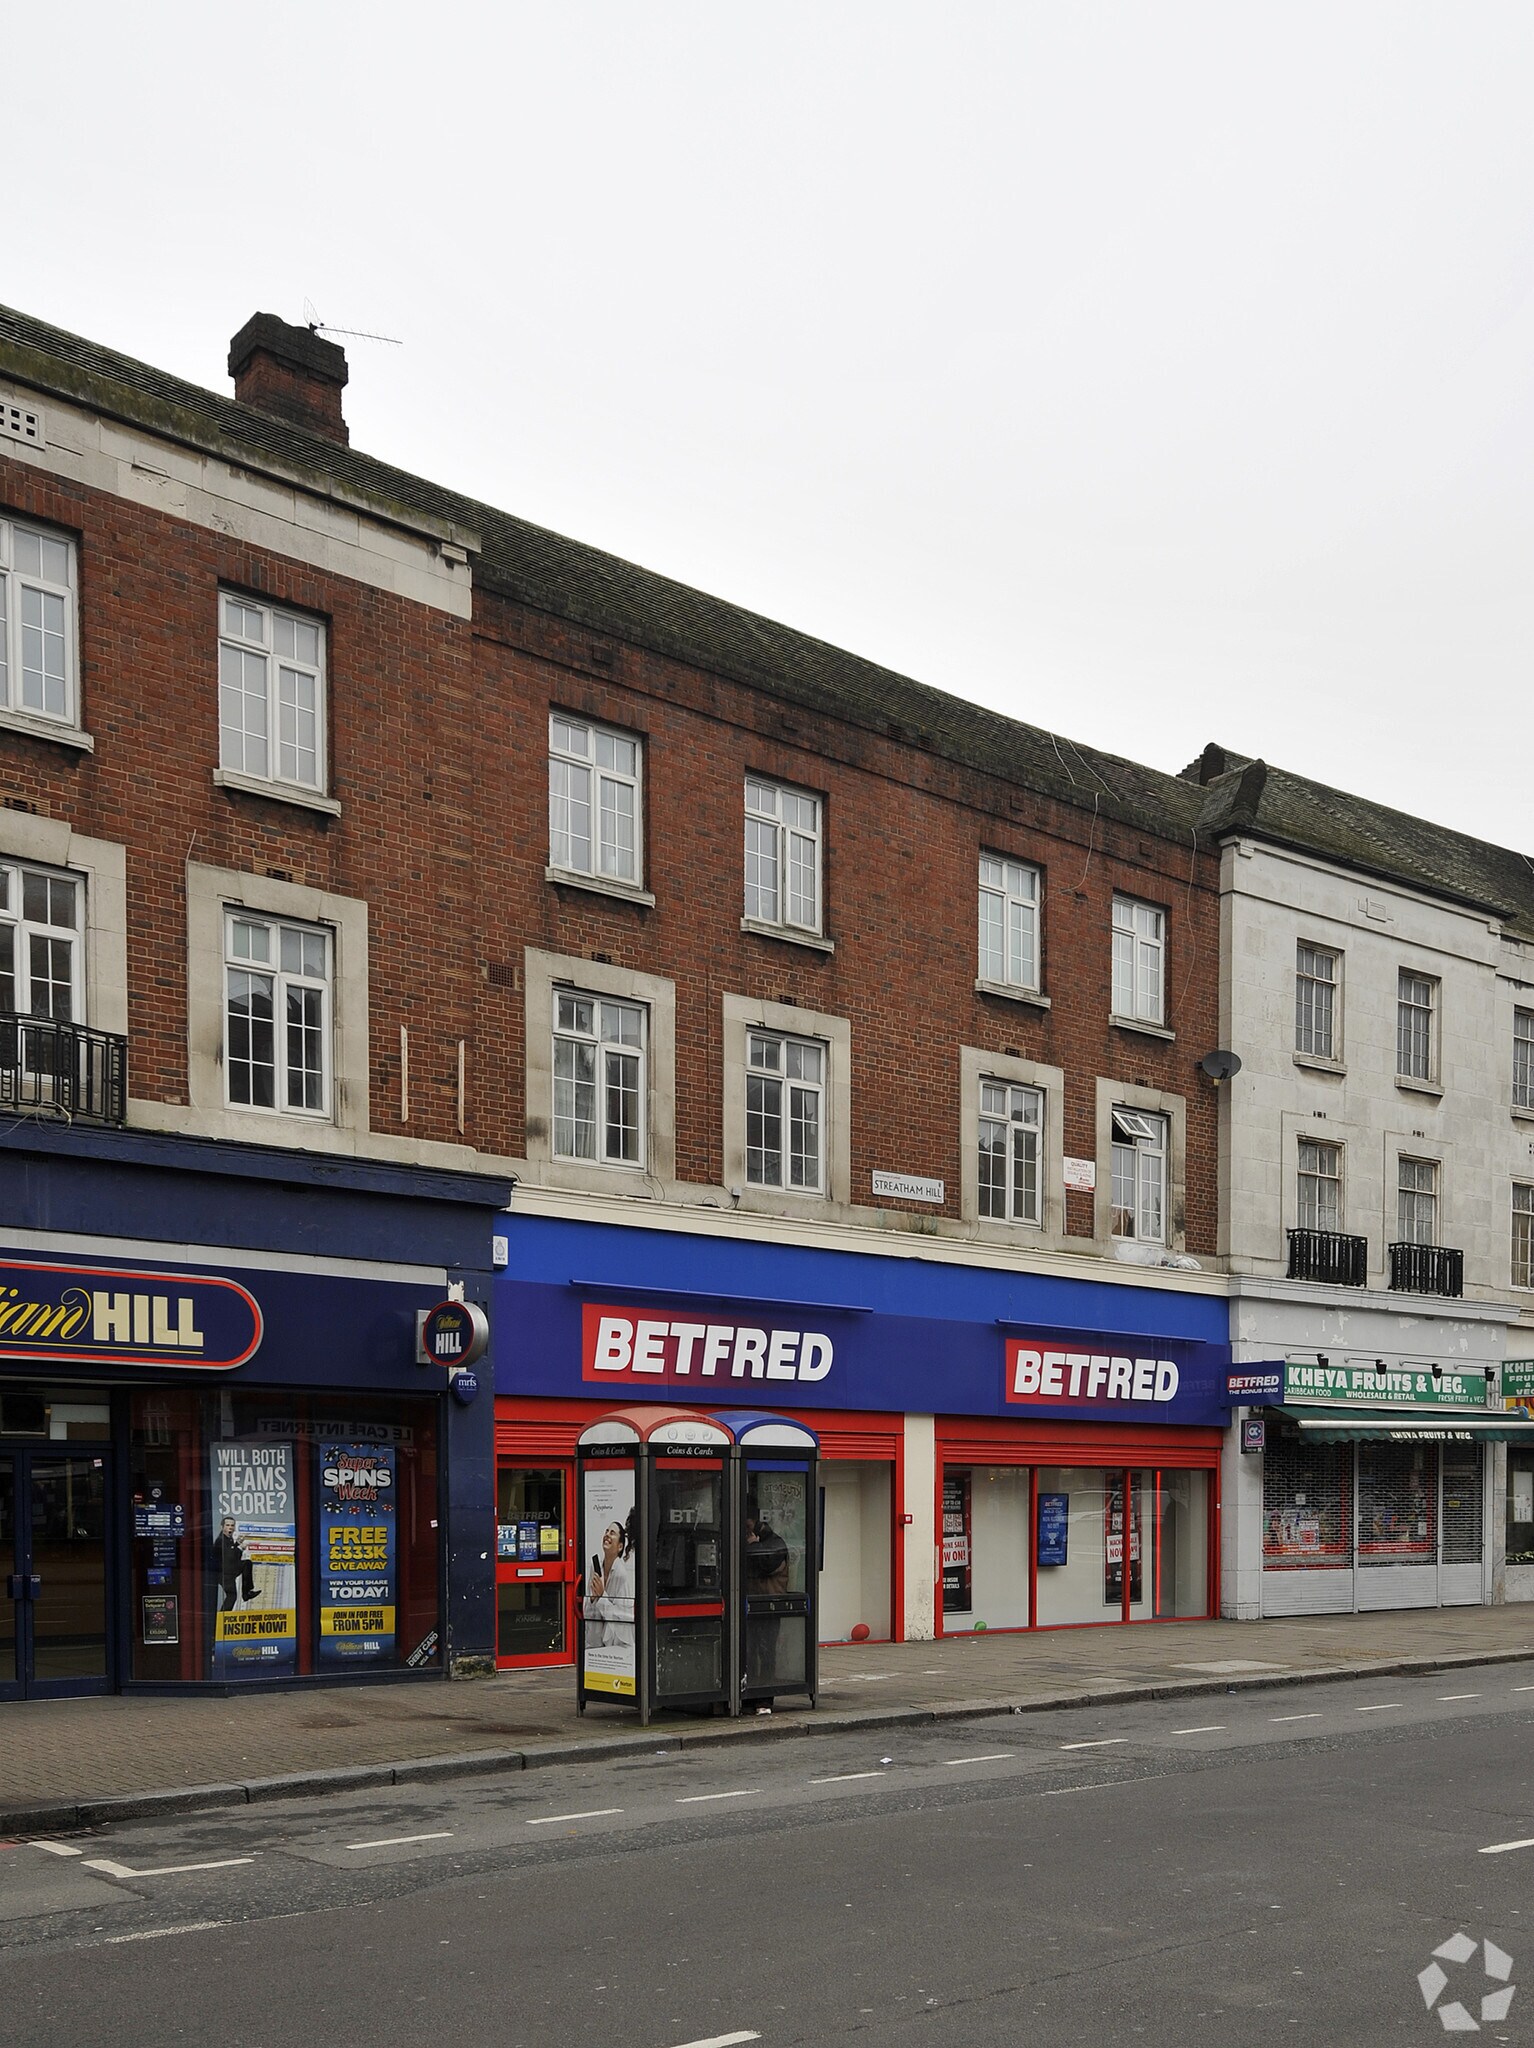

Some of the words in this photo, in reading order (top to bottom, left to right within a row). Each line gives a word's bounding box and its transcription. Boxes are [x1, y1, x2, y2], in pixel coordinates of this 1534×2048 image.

[874, 1179, 923, 1195] STREATHAM
[925, 1187, 942, 1198] HILL
[0, 1286, 92, 1340] iam
[93, 1291, 204, 1347] HILL
[435, 1332, 462, 1354] HILL
[593, 1316, 834, 1382] BETFRED
[458, 1376, 477, 1387] mrfs
[1013, 1349, 1180, 1402] BETFRED
[1228, 1375, 1280, 1388] BETFRED
[1288, 1367, 1348, 1389] KHEYA
[1352, 1371, 1412, 1392] FRUITS
[1415, 1373, 1427, 1393] &
[1431, 1375, 1467, 1394] VEG.
[1315, 1388, 1332, 1397] FOOD
[1345, 1391, 1387, 1400] WHOLESALE
[1387, 1392, 1393, 1400] &
[1393, 1393, 1416, 1401] RETAIL
[1418, 1431, 1445, 1440] FRUITS
[1447, 1431, 1453, 1439] &
[1454, 1431, 1473, 1440] VEG.
[217, 1449, 249, 1466] WILL
[252, 1449, 286, 1466] BOTH
[590, 1447, 605, 1456] Coins
[605, 1447, 610, 1455] &
[610, 1446, 626, 1455] Cards
[666, 1446, 685, 1455] Coins
[685, 1446, 693, 1455] &
[693, 1446, 714, 1456] Cards
[337, 1452, 378, 1472] Super
[217, 1466, 287, 1492] TEAMS
[323, 1468, 392, 1487] SPINS
[333, 1482, 379, 1501] Week
[218, 1491, 288, 1516] SCORE?
[507, 1511, 551, 1520] BETFRED
[669, 1509, 695, 1524] BT
[329, 1527, 388, 1545] FREE
[497, 1530, 517, 1539] 21?
[329, 1545, 388, 1560] £333K
[952, 1550, 966, 1560] ON!
[329, 1561, 388, 1571] GIVEAWAY
[329, 1586, 389, 1599] TODAY!
[224, 1615, 238, 1623] PICK
[263, 1613, 287, 1621] COUPON
[333, 1611, 347, 1619] JOIN
[369, 1610, 384, 1618] FREE
[223, 1622, 257, 1635] INSIDE
[258, 1620, 287, 1633] NOW!
[333, 1619, 360, 1631] FROM
[362, 1618, 384, 1631] 5PM
[261, 1645, 279, 1655] HILL
[363, 1641, 380, 1650] HILL
[408, 1648, 424, 1667] DEBIT
[422, 1632, 439, 1651] CARD
